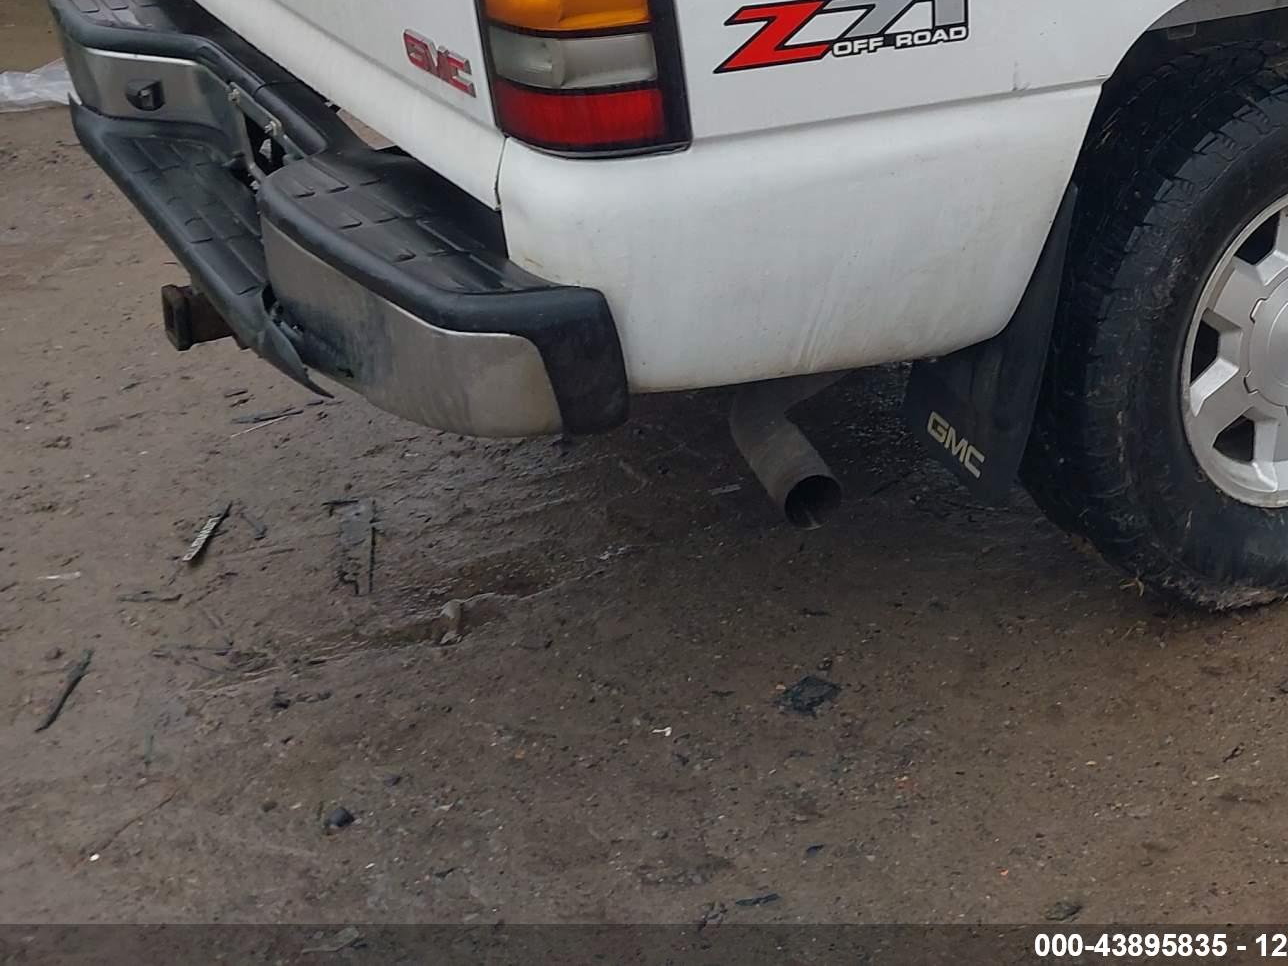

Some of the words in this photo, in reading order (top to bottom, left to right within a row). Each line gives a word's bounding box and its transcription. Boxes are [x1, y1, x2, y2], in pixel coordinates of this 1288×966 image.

[402, 28, 477, 98] GMC
[832, 36, 884, 57] OFF
[895, 26, 967, 49] ROAD
[926, 410, 985, 479] GMC
